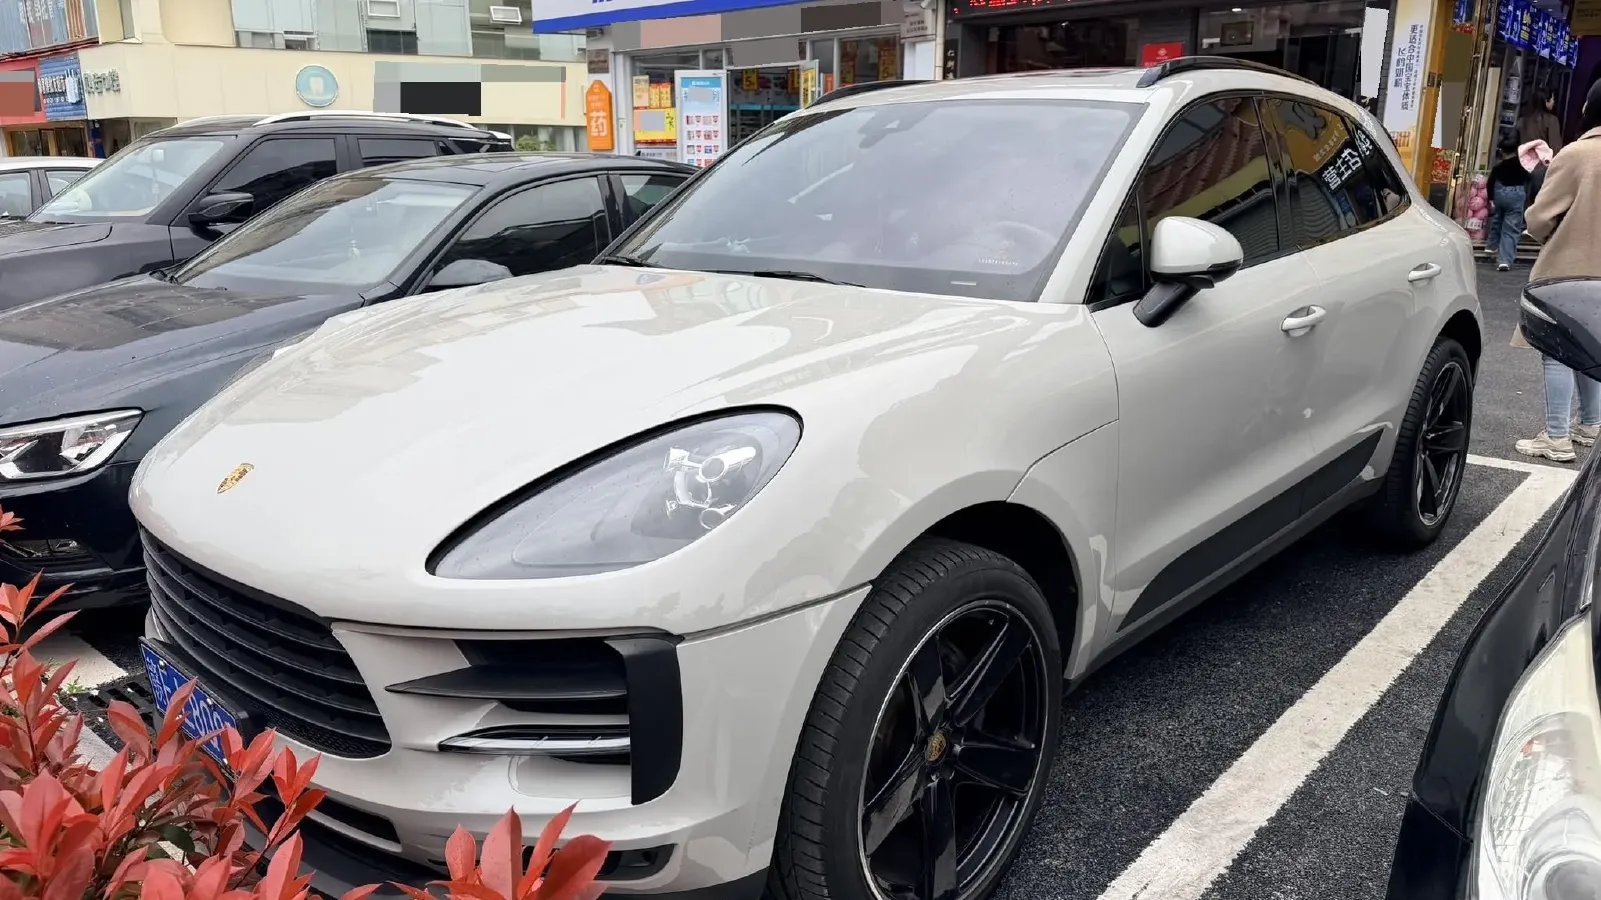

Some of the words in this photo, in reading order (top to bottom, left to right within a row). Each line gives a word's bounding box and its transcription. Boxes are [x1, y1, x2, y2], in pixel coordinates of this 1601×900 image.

[1401, 24, 1419, 111] 更适合中国宝宝体质
[588, 110, 608, 138] 药
